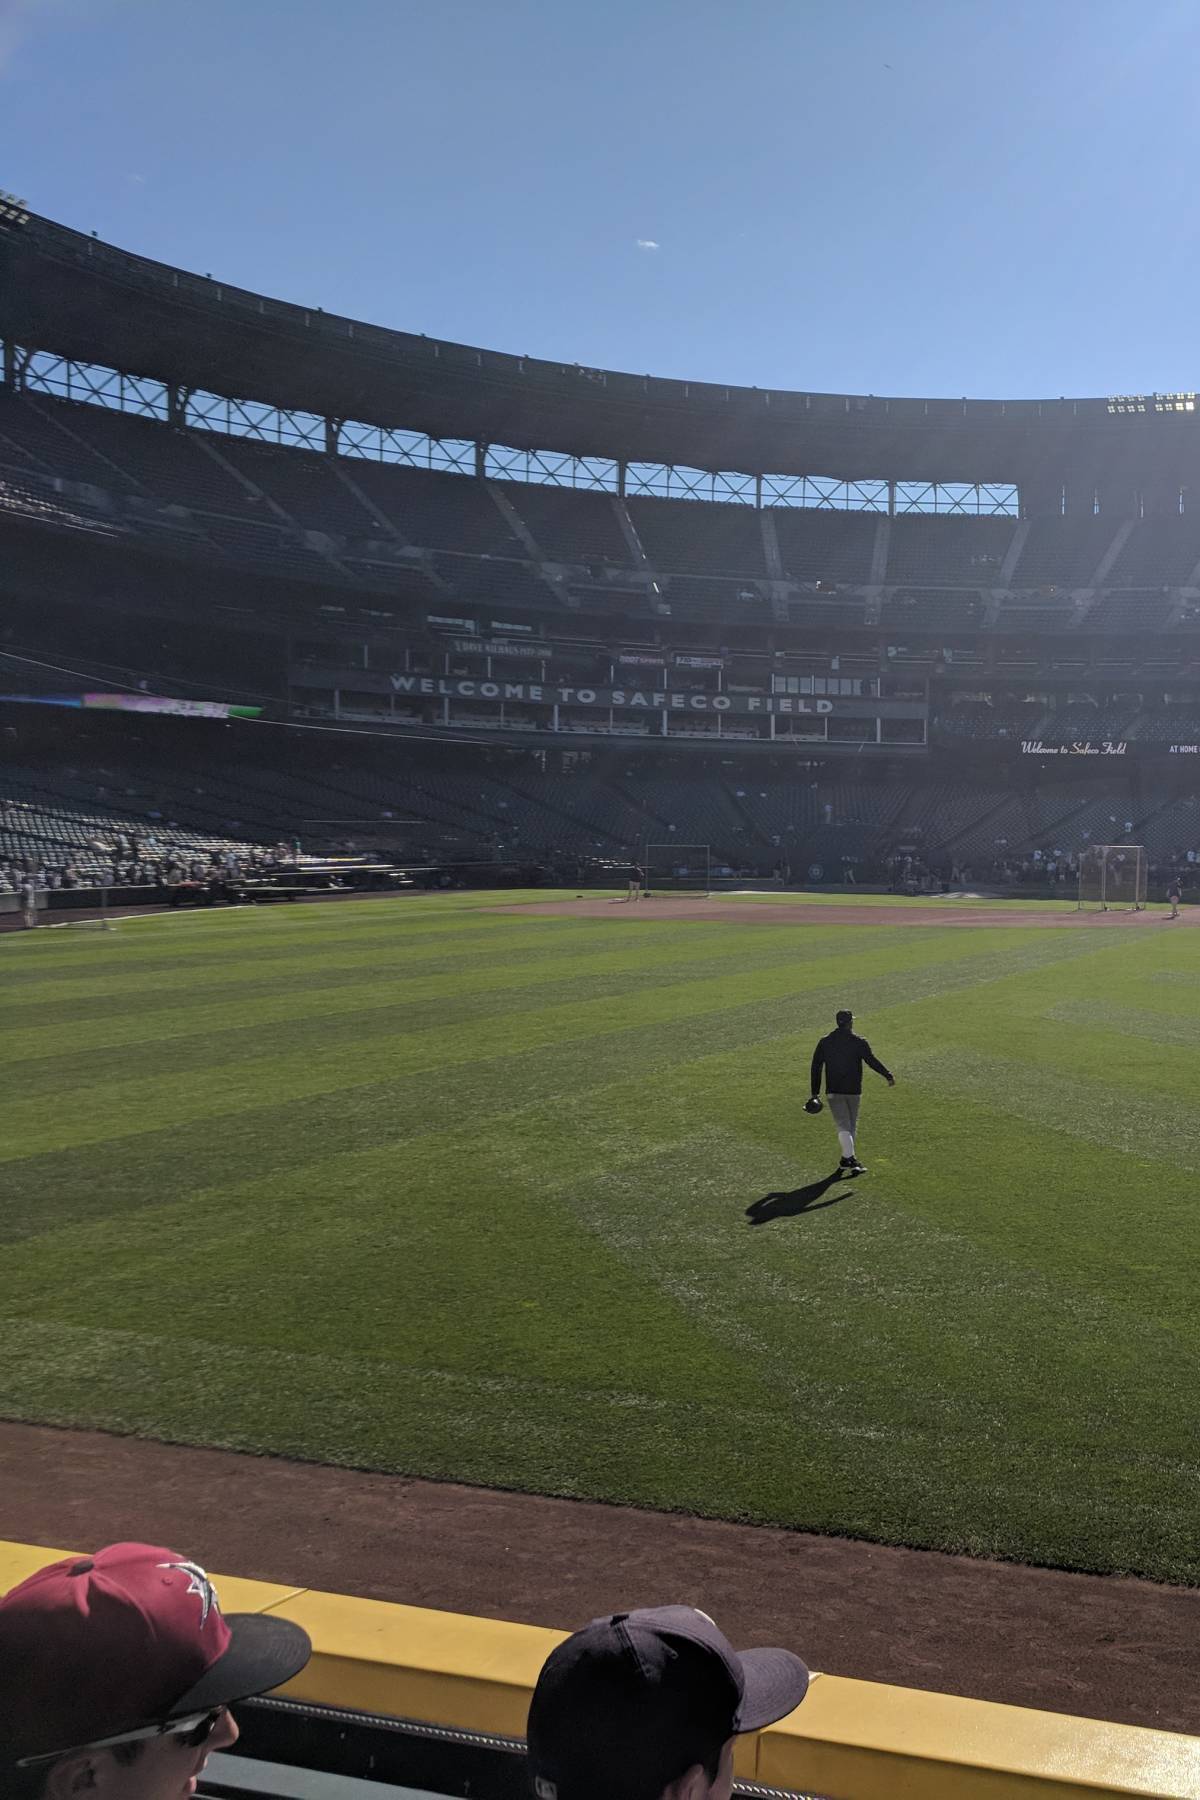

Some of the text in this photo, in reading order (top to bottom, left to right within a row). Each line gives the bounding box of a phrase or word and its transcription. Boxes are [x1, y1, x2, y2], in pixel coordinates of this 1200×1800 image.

[390, 674, 833, 713] WELCOME TO SAFECO FIELD
[1021, 741, 1127, 755] Welcome to Safeco Field
[1169, 745, 1178, 754] AT
[1180, 745, 1198, 754] HOME
